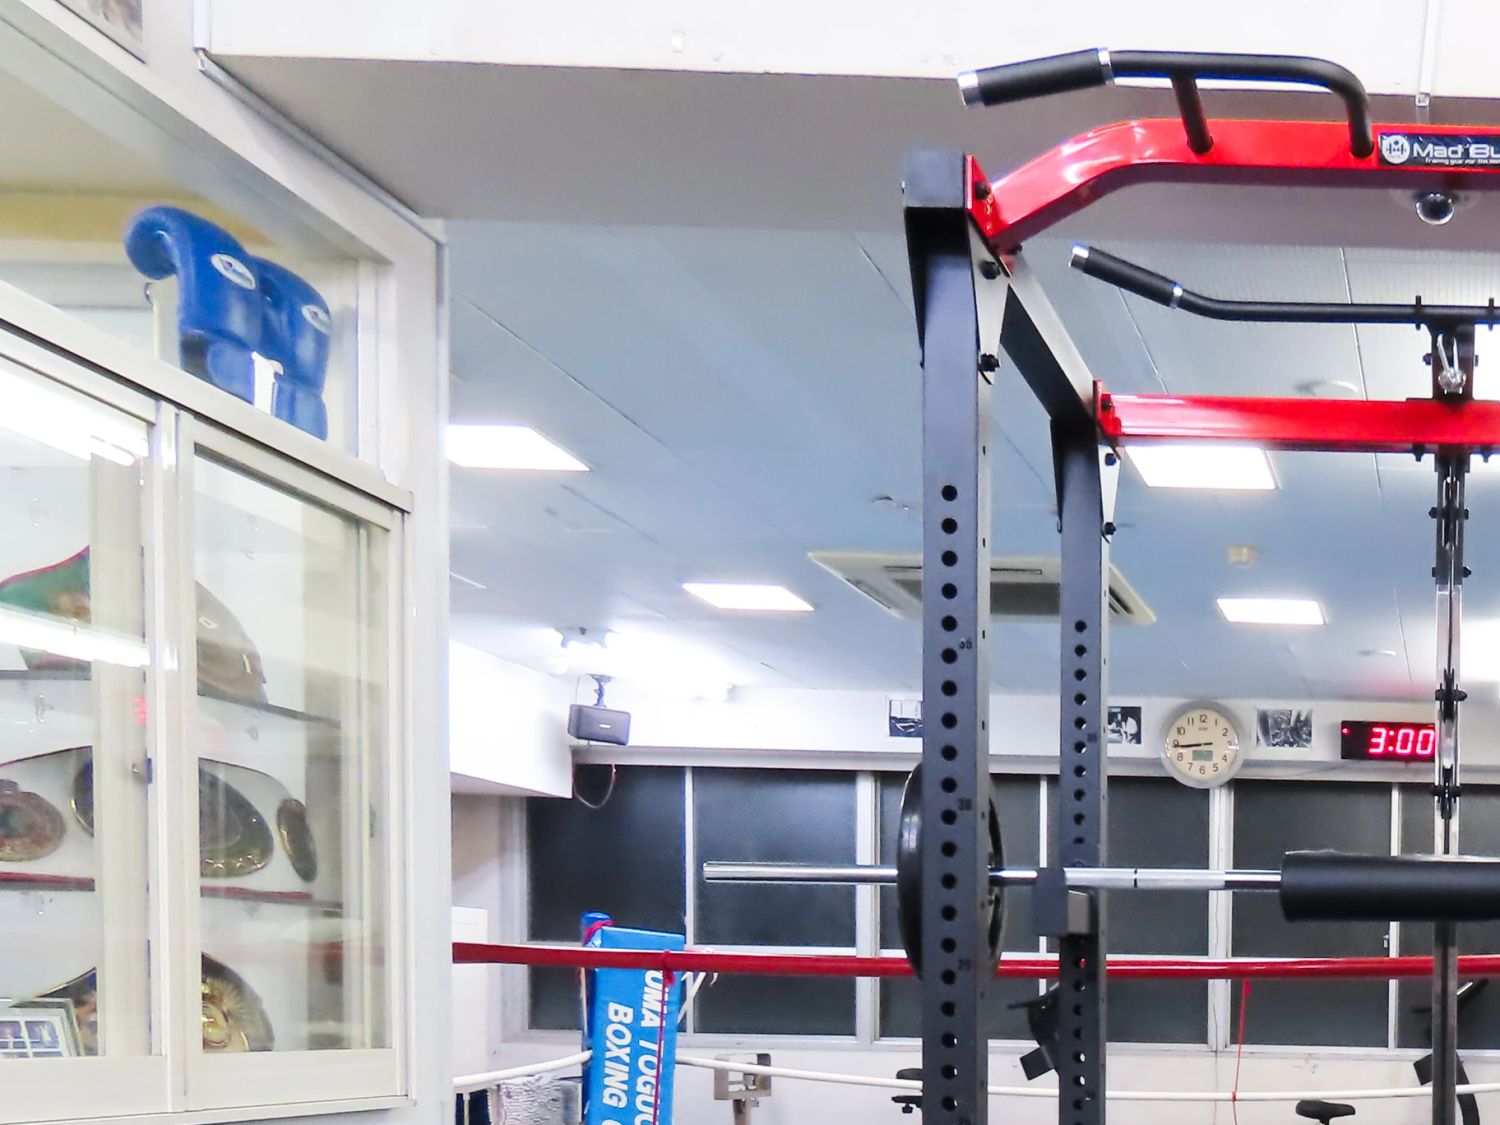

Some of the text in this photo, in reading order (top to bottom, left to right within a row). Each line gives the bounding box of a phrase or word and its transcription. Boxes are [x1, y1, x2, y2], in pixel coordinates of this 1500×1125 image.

[1413, 142, 1463, 158] Mad
[1368, 727, 1435, 755] 3:00
[641, 971, 669, 1028] UMA
[602, 1001, 635, 1109] BOXING
